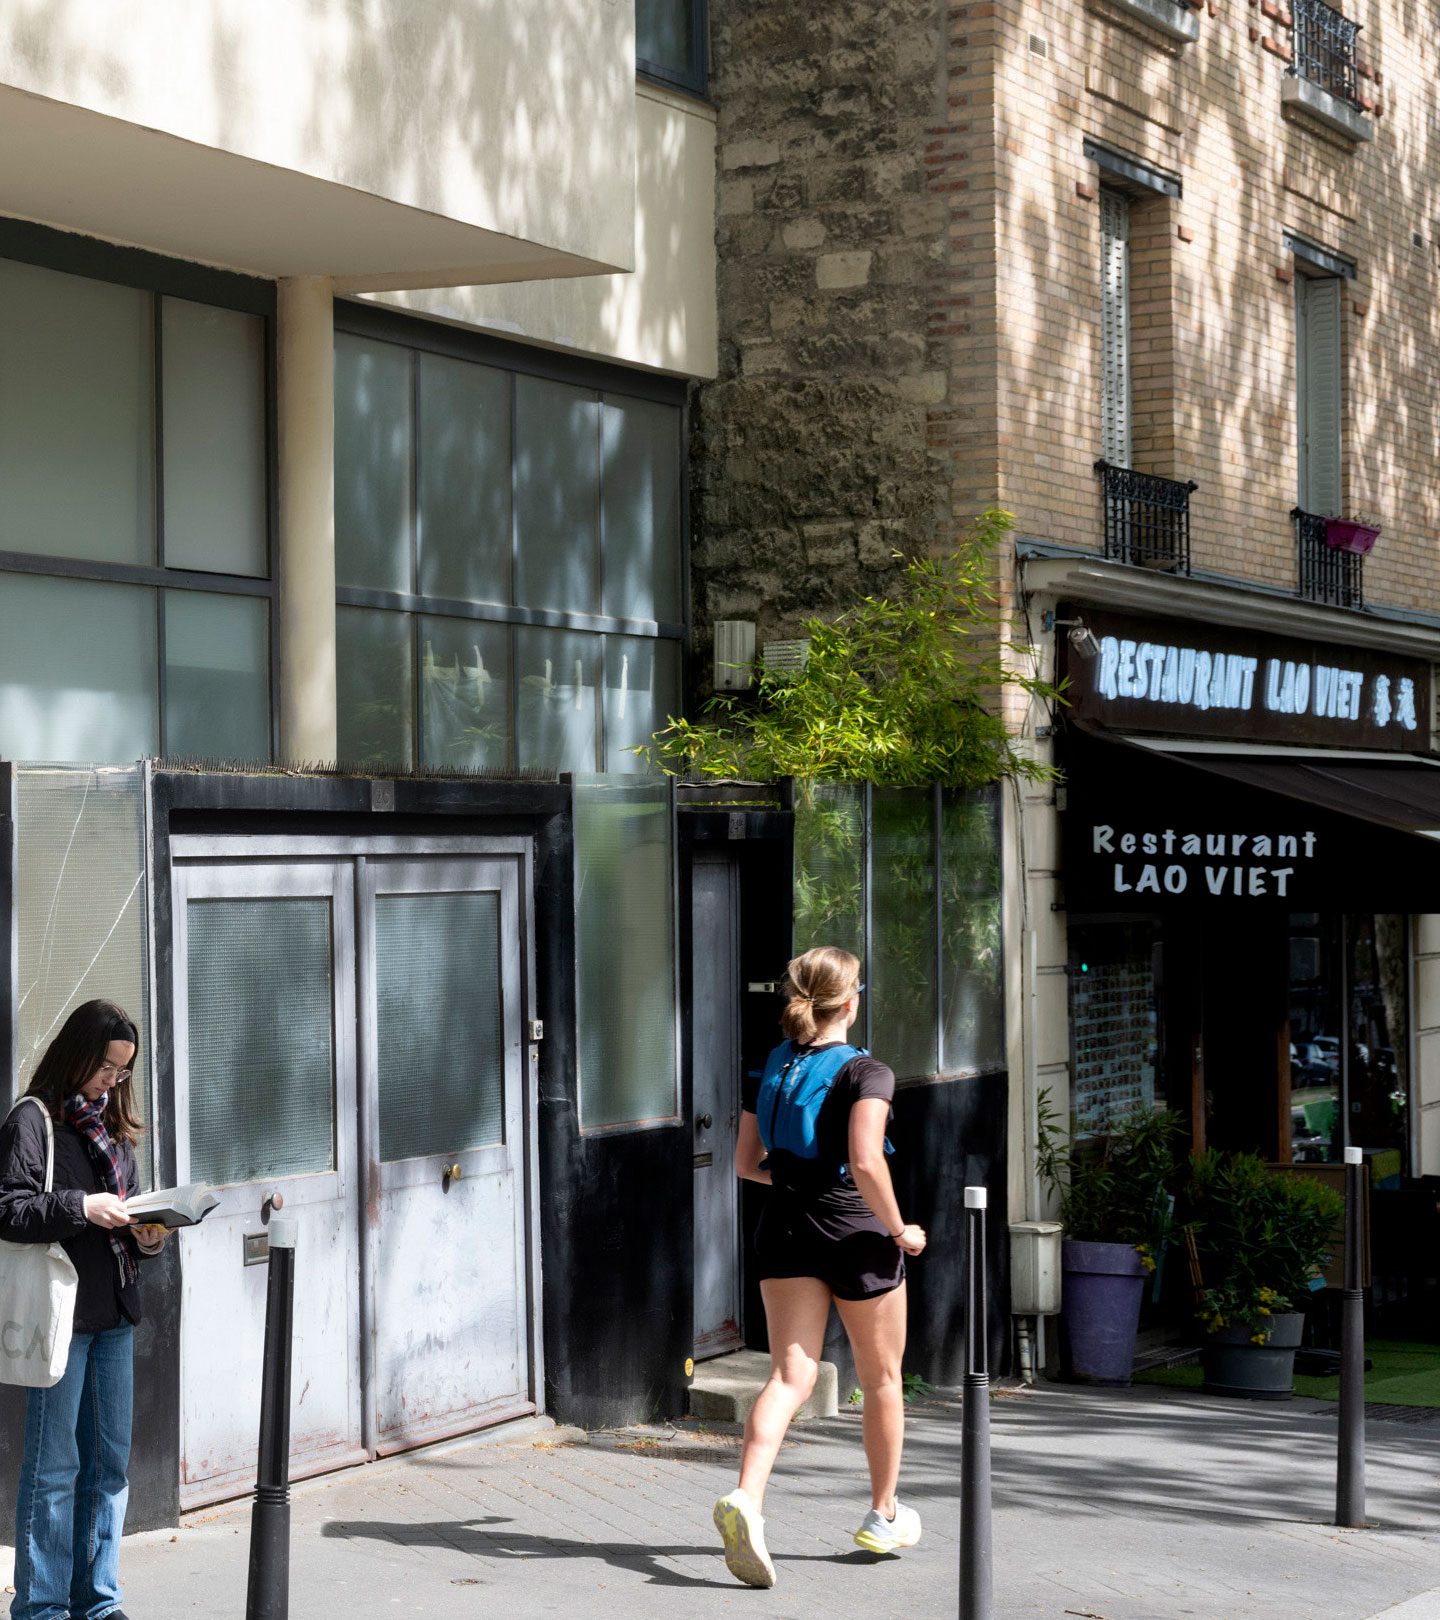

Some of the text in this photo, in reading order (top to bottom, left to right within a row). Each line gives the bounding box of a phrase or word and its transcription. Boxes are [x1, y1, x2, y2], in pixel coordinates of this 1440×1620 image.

[1098, 636, 1258, 711] RESTAURANT
[1266, 658, 1310, 714] LAO
[1314, 665, 1364, 720] VIET
[1093, 825, 1317, 858] Restaurant
[1114, 863, 1294, 897] LAO VIET
